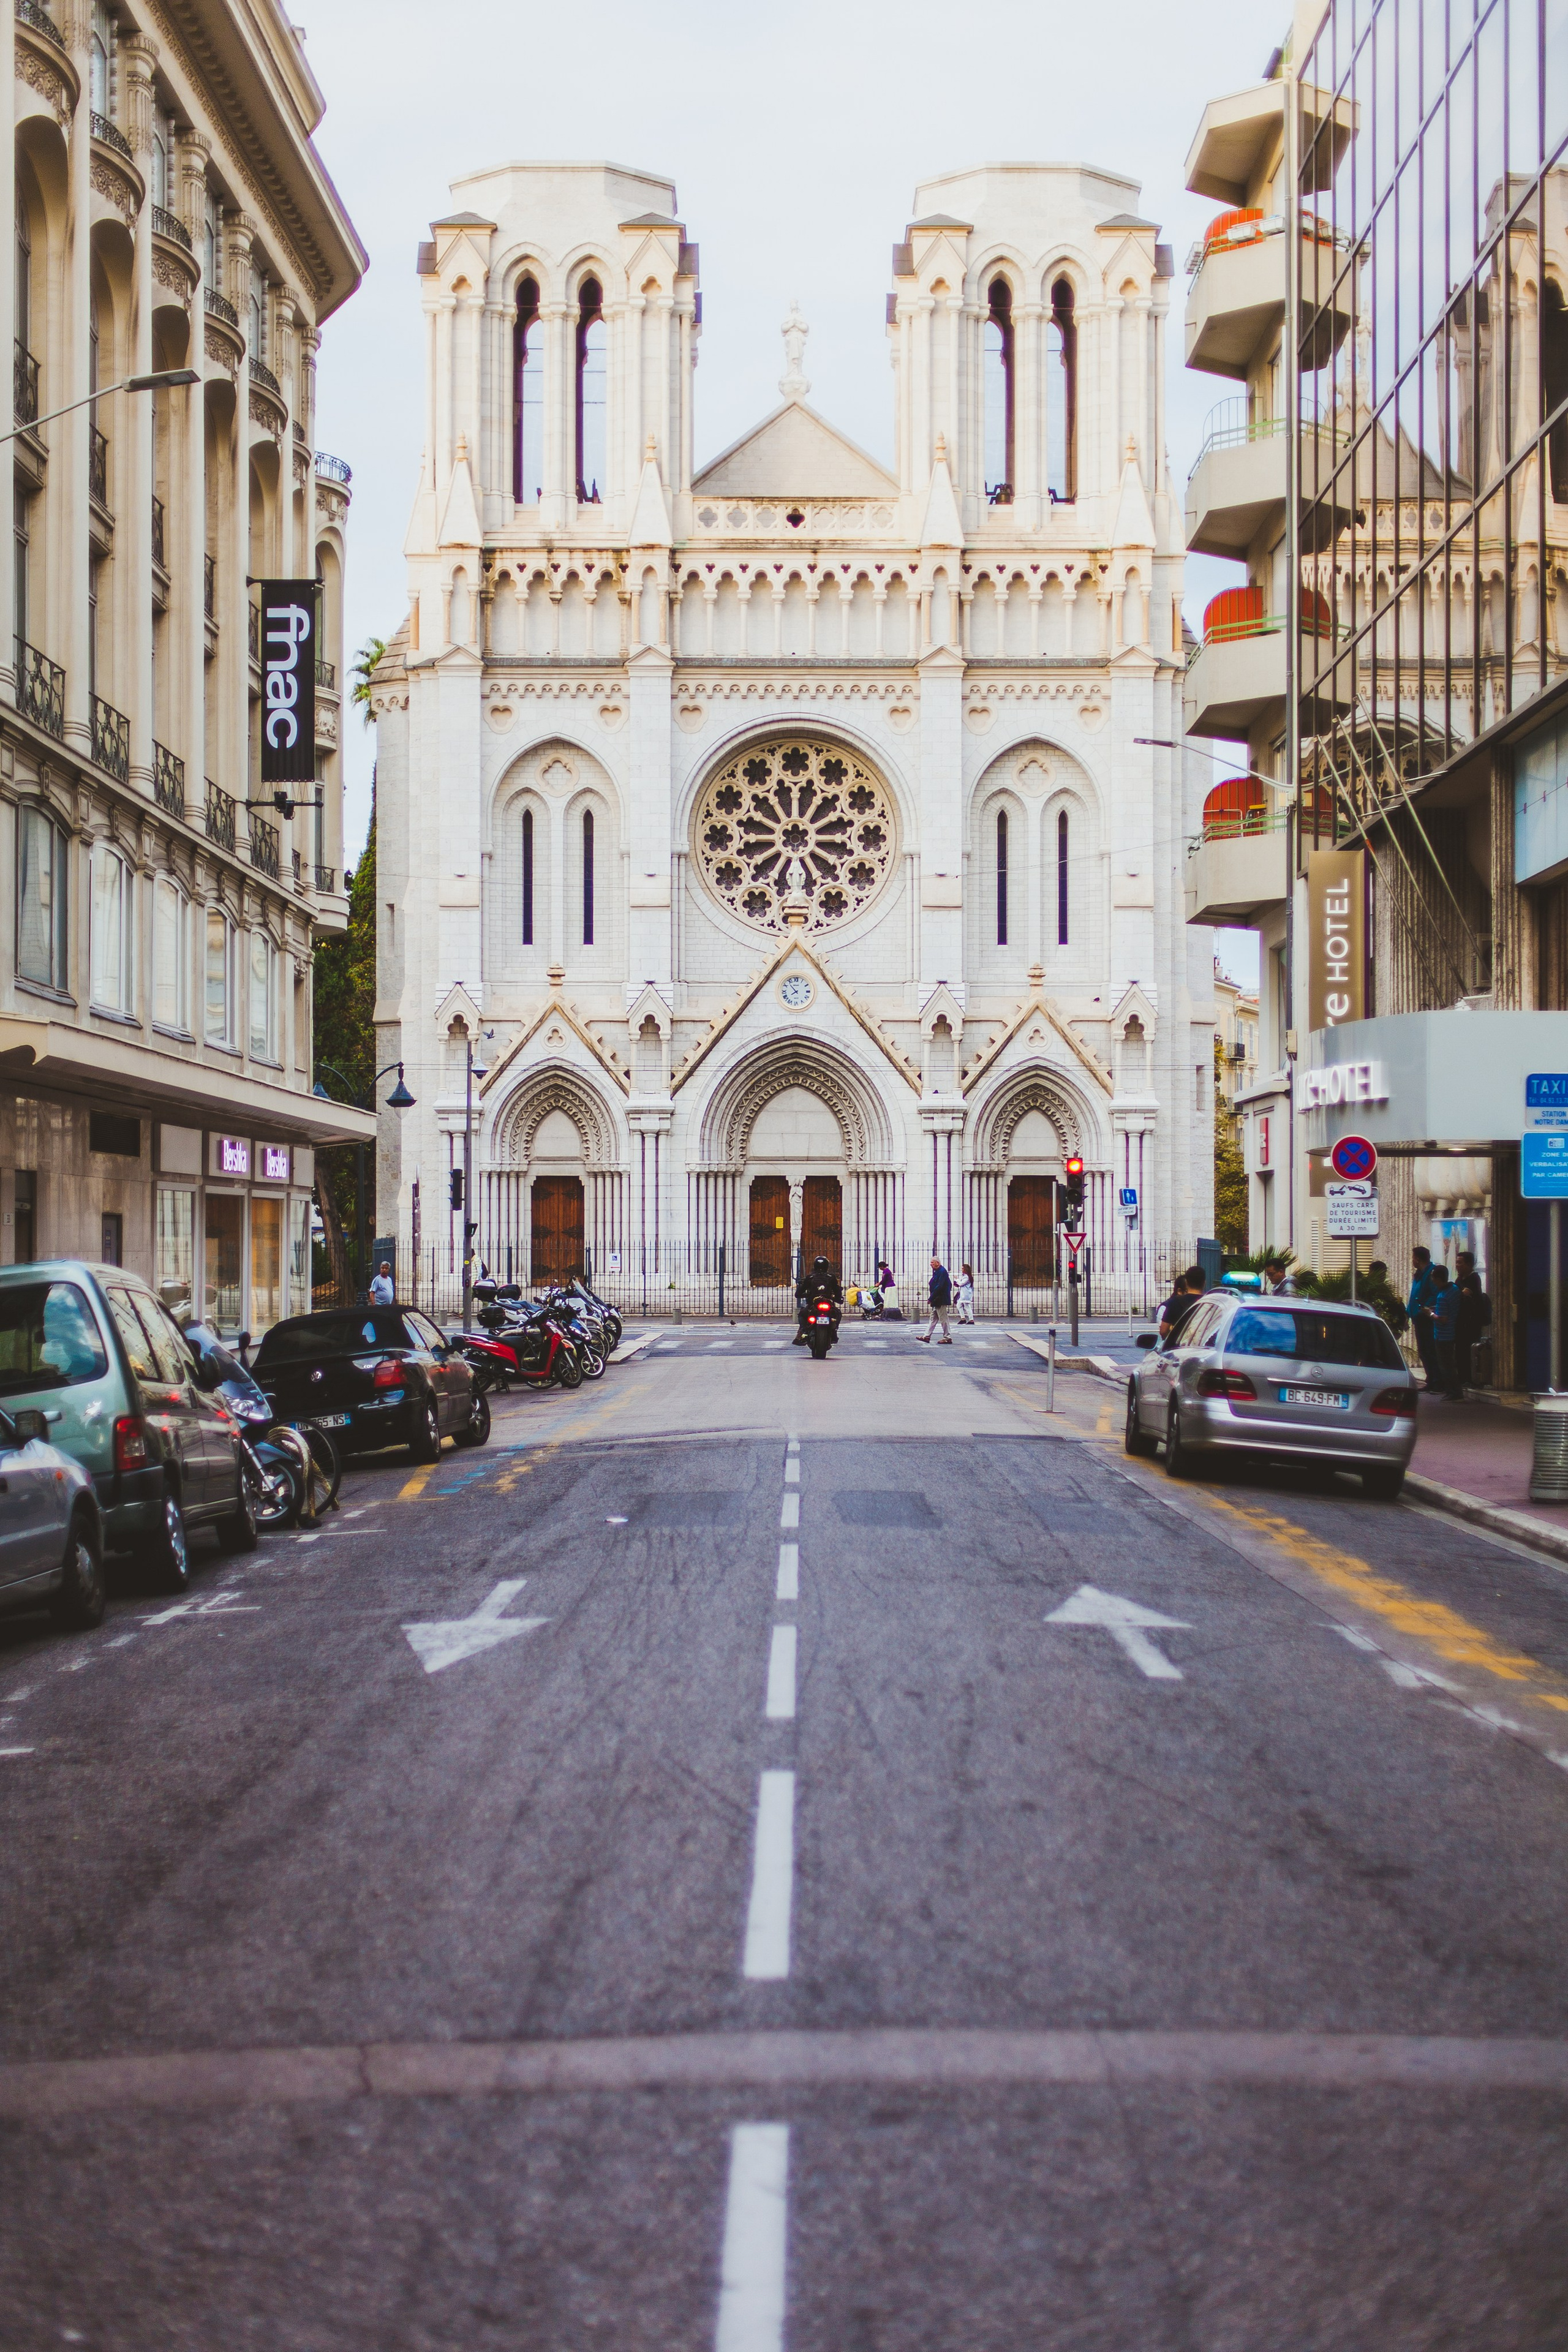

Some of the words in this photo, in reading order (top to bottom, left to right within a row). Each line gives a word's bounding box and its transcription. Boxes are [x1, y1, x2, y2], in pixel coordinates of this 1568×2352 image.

[266, 604, 310, 748] fnac
[1326, 878, 1349, 981] HOTEL
[1320, 1061, 1389, 1105] HOTEL
[224, 1140, 247, 1172] Bershka
[266, 1148, 287, 1177] Bershka
[1287, 1389, 1340, 1406] BC-649-FM
